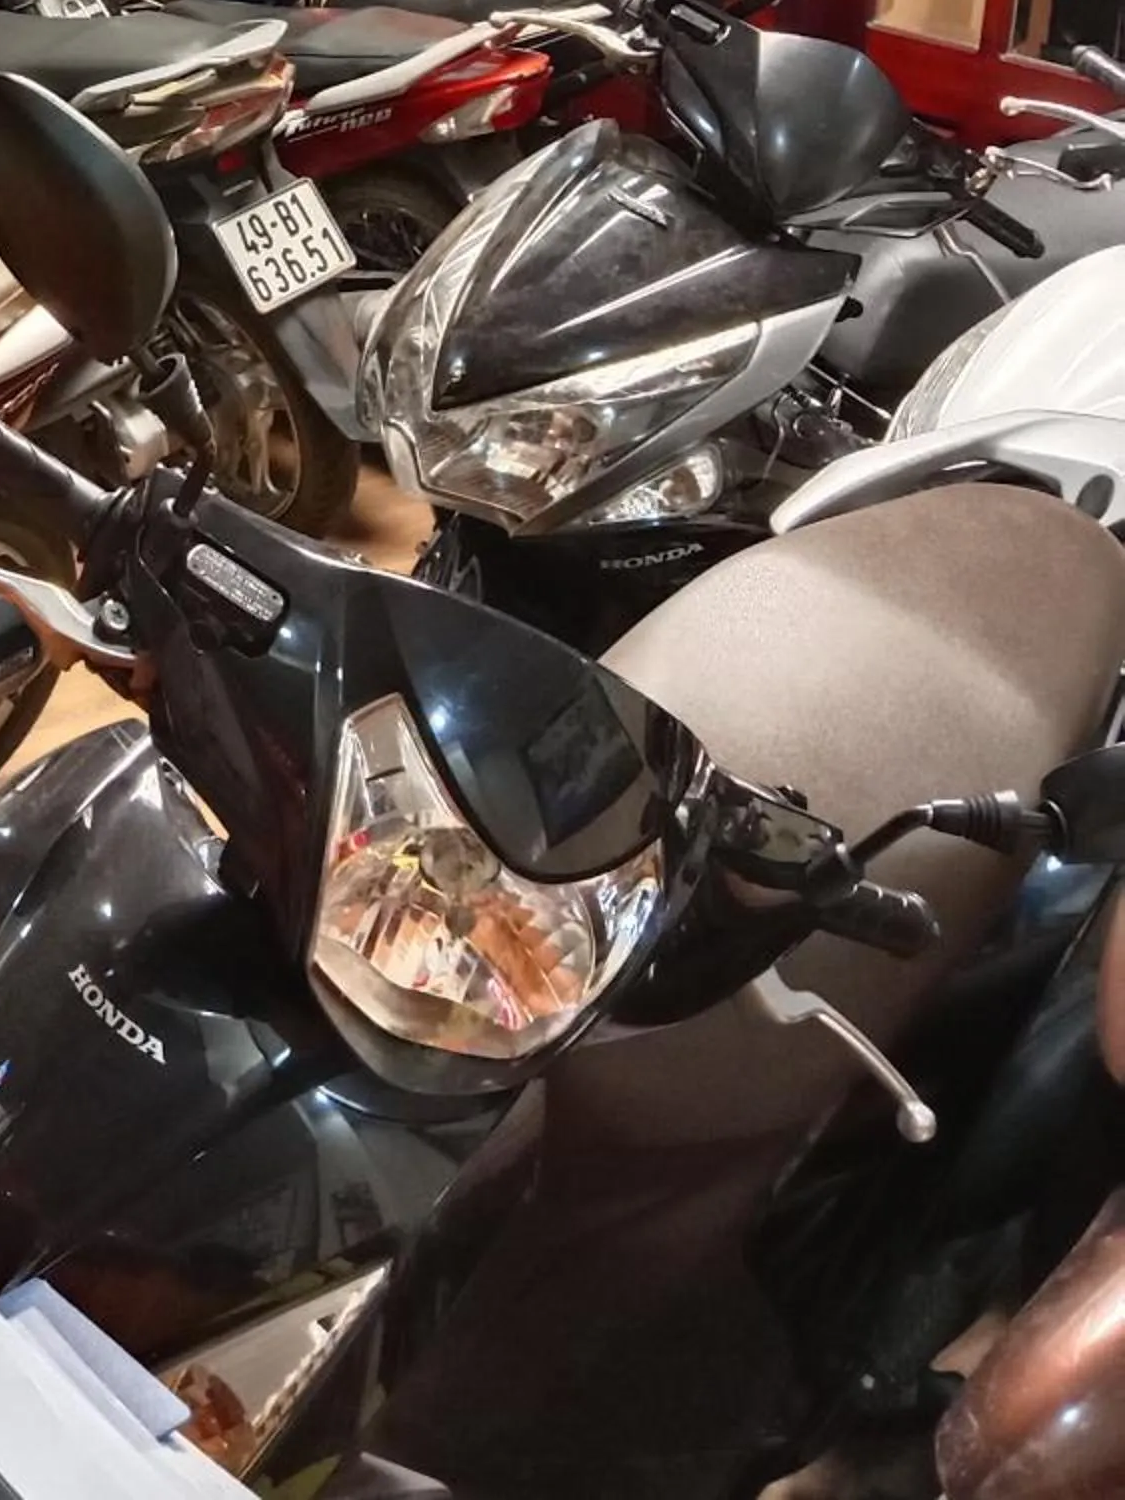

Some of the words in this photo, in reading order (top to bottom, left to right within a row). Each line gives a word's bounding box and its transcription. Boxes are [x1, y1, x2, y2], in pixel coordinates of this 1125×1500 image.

[235, 192, 313, 255] 49-B1
[246, 227, 345, 303] 636.51
[600, 543, 704, 569] HONDA
[68, 963, 167, 1065] HONDA
